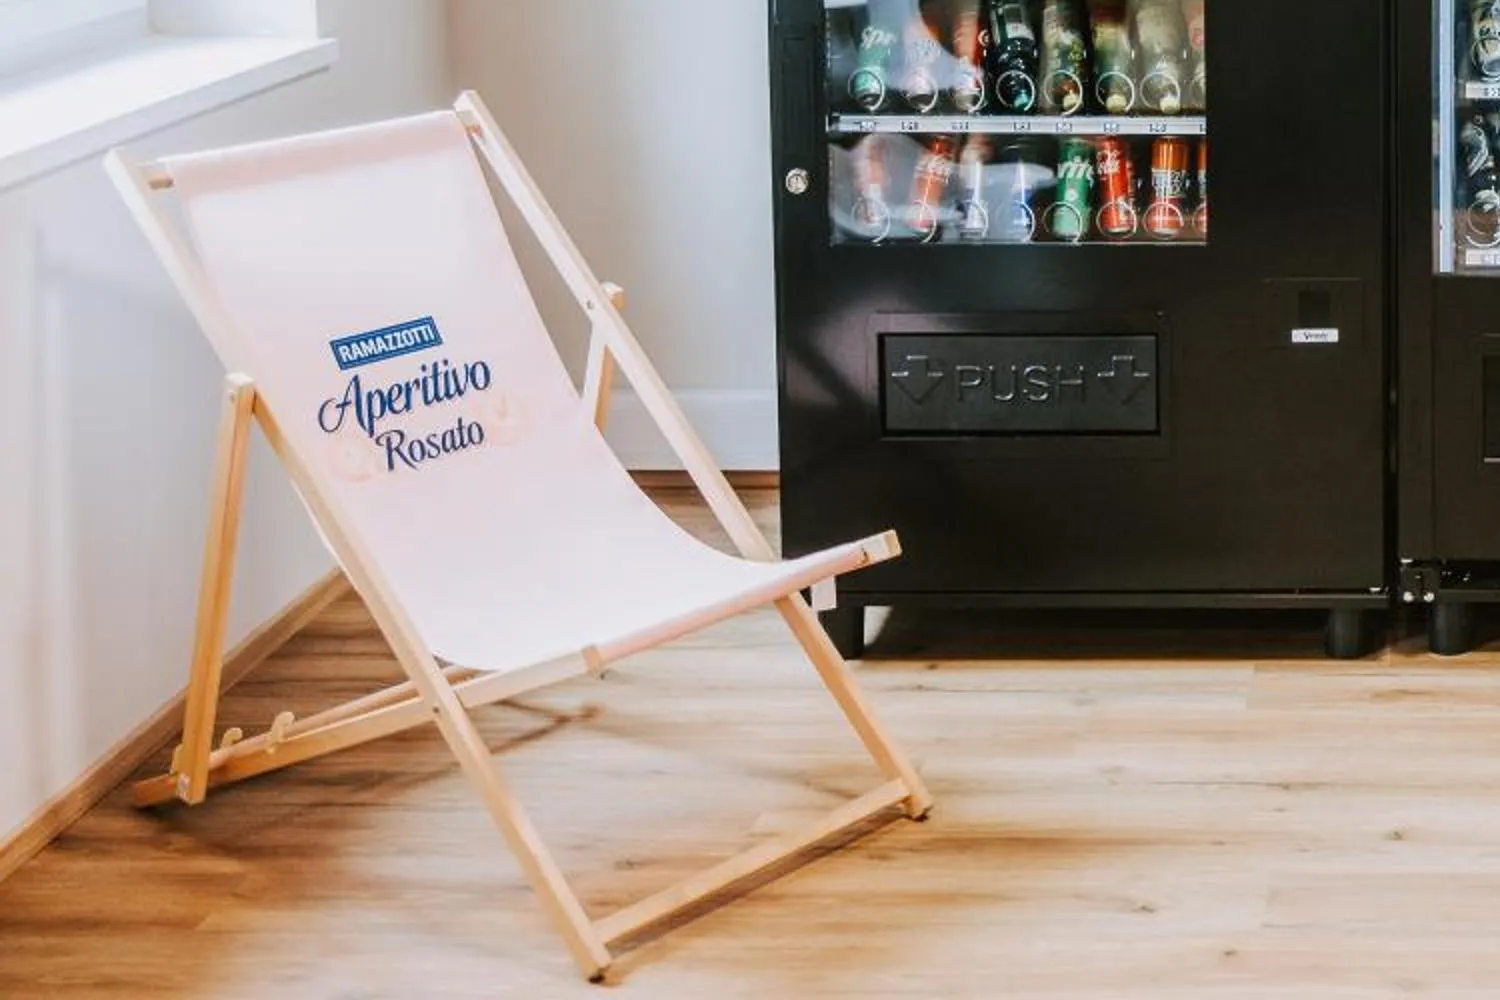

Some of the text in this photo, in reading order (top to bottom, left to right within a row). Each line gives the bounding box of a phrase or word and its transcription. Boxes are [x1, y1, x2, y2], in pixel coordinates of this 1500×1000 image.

[339, 326, 435, 363] RAMAZZOTTI
[318, 358, 491, 438] Aperitivo
[956, 365, 1084, 402] PUSH
[375, 416, 485, 471] Rosato
